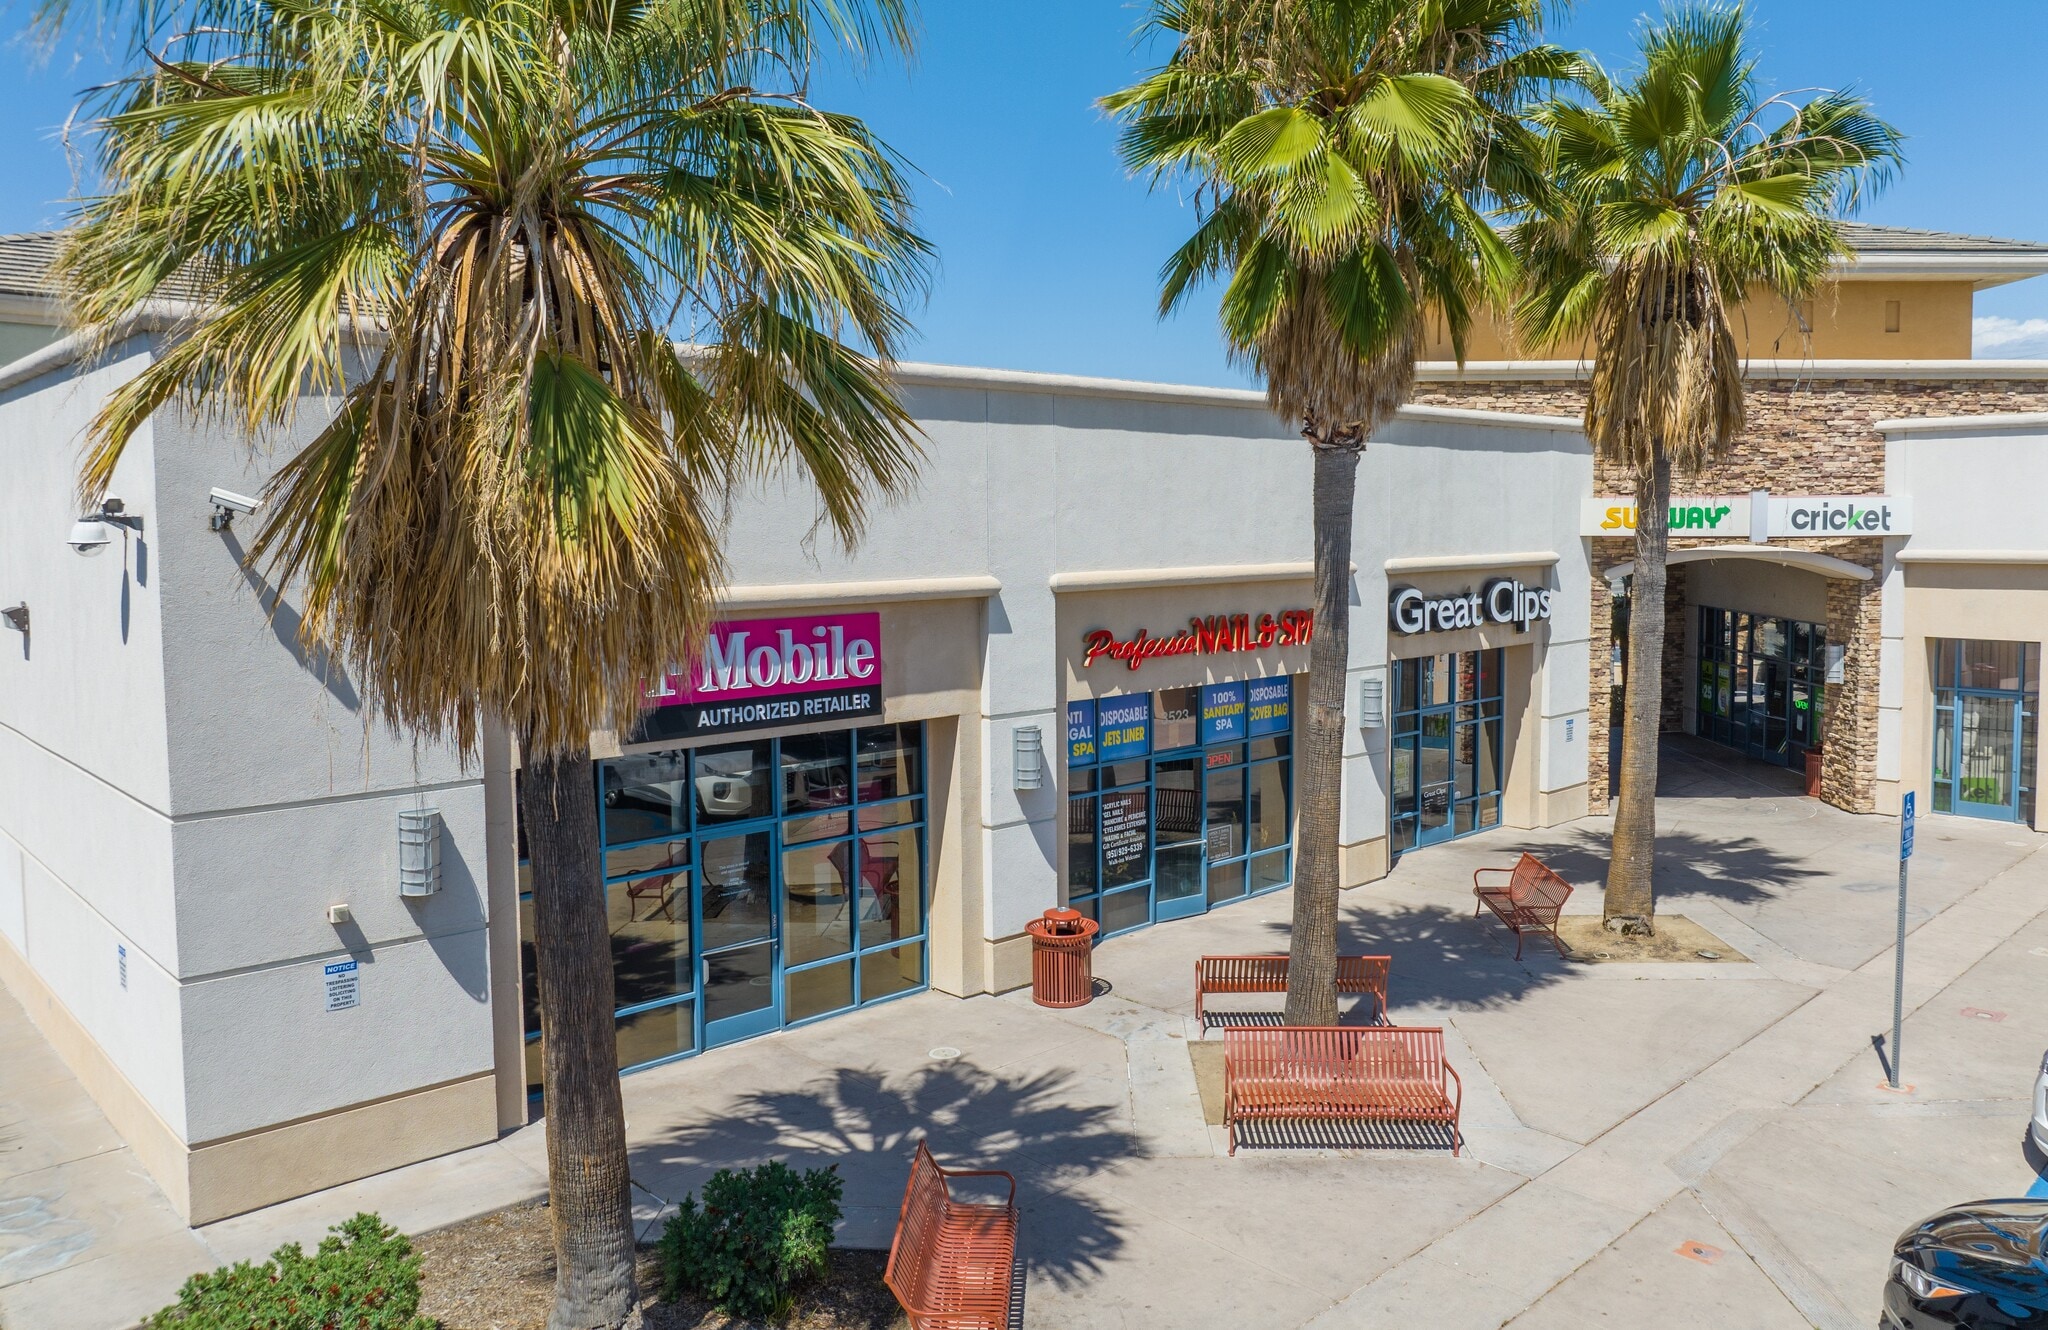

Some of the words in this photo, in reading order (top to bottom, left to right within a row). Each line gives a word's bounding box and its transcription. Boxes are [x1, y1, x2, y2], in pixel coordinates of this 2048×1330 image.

[1600, 505, 1731, 530] SUWAY
[1791, 502, 1891, 531] cricket
[1393, 587, 1483, 634] Great
[1486, 579, 1550, 632] Clips
[697, 625, 875, 693] Mobile
[1212, 690, 1236, 704] 100%
[697, 701, 801, 728] AUTHORIZED
[803, 693, 871, 716] RETAILER
[1100, 706, 1148, 726] DISPOSABLE
[1203, 703, 1245, 719] SANITARY
[1273, 703, 1288, 716] BAG
[1067, 711, 1083, 725] NTI
[1215, 718, 1233, 731] SPA
[1069, 726, 1093, 740] GAL
[1102, 730, 1121, 747] JETS
[1123, 726, 1145, 743] LINER
[1073, 742, 1095, 757] SPA
[327, 963, 356, 973] NOTICE
[326, 977, 358, 986] TRESPASSING
[329, 983, 355, 991] LOITERING
[329, 988, 356, 997] SOLICITING
[330, 1000, 355, 1008] PROPERTY
